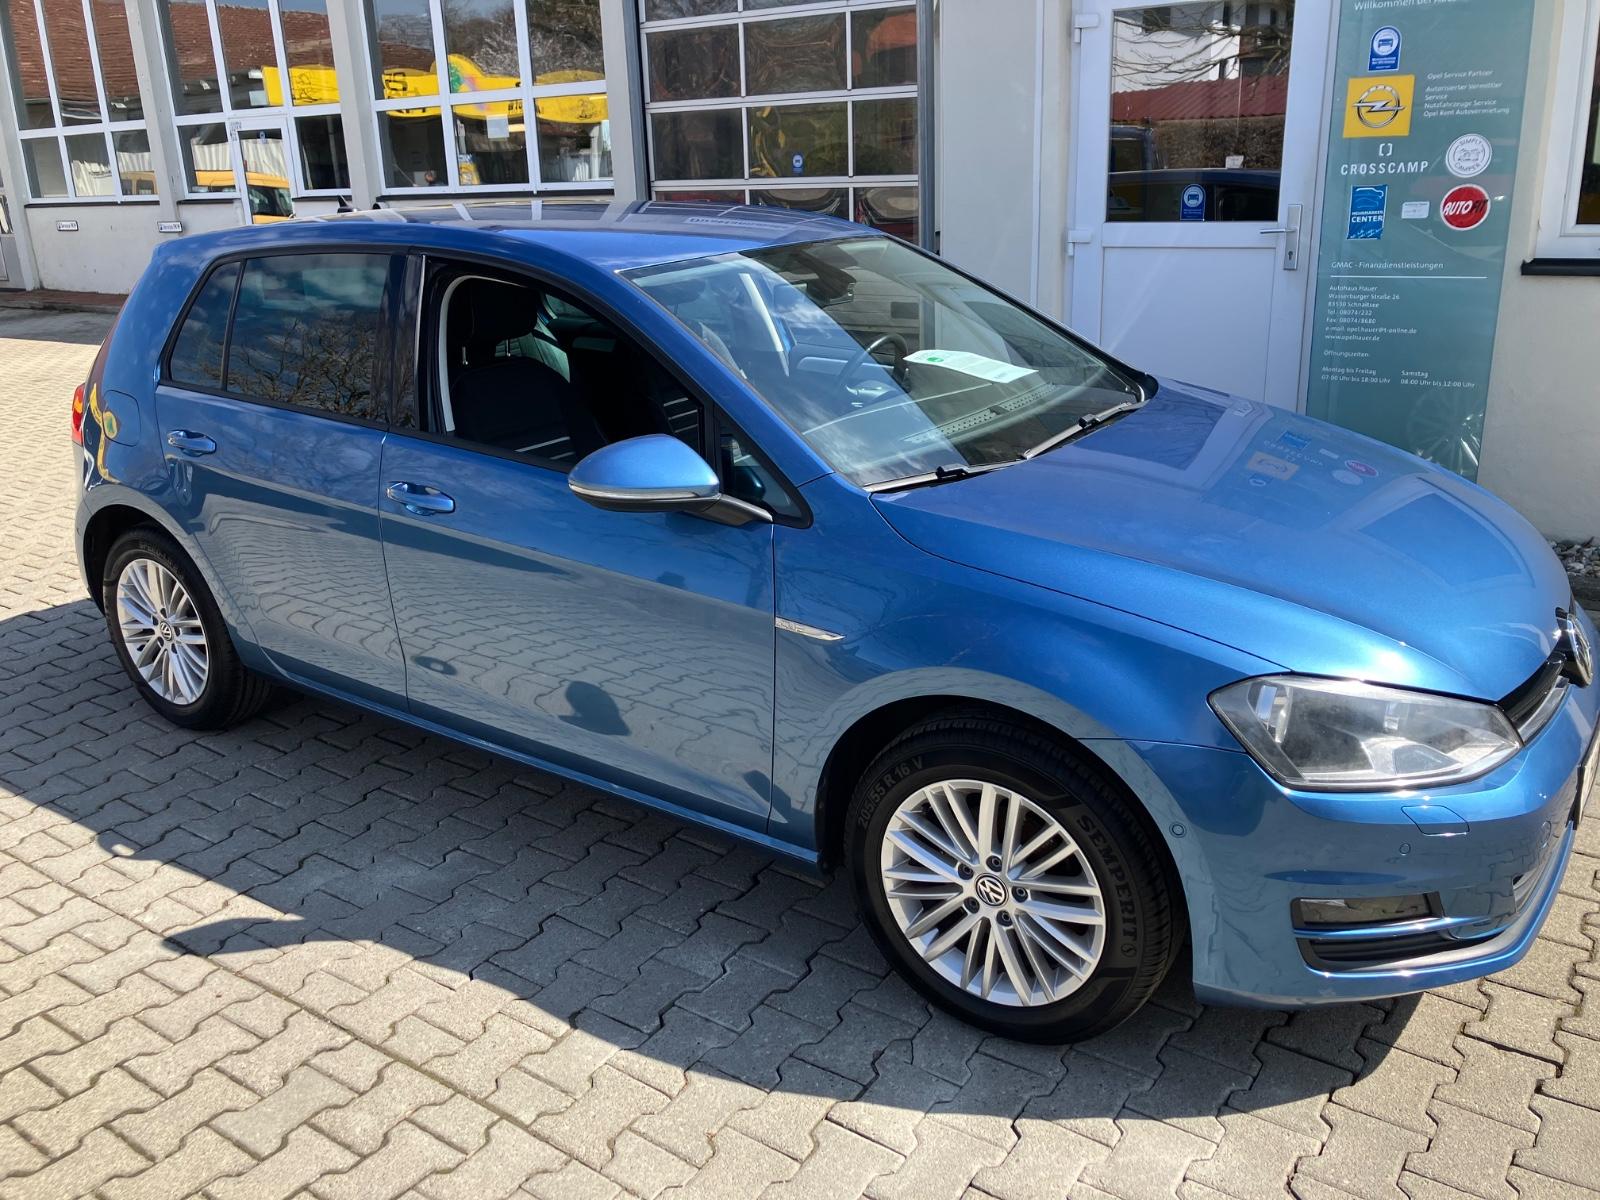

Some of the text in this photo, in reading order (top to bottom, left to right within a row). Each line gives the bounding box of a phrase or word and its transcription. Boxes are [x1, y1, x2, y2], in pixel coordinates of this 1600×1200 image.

[1427, 72, 1442, 80] Opel
[1444, 71, 1467, 79] Service
[1459, 136, 1482, 146] SIMPLY
[1340, 161, 1428, 176] CROSSCAMP
[1454, 162, 1482, 172] CAMPER
[1358, 262, 1444, 270] Finanzdienstleistungen
[1322, 366, 1344, 374] Montag
[1355, 368, 1376, 376] Freitag
[1401, 370, 1429, 378] Samstag
[884, 773, 896, 787] R
[894, 762, 910, 778] 16
[912, 756, 922, 769] V
[1076, 815, 1138, 938] SEMPERIT
